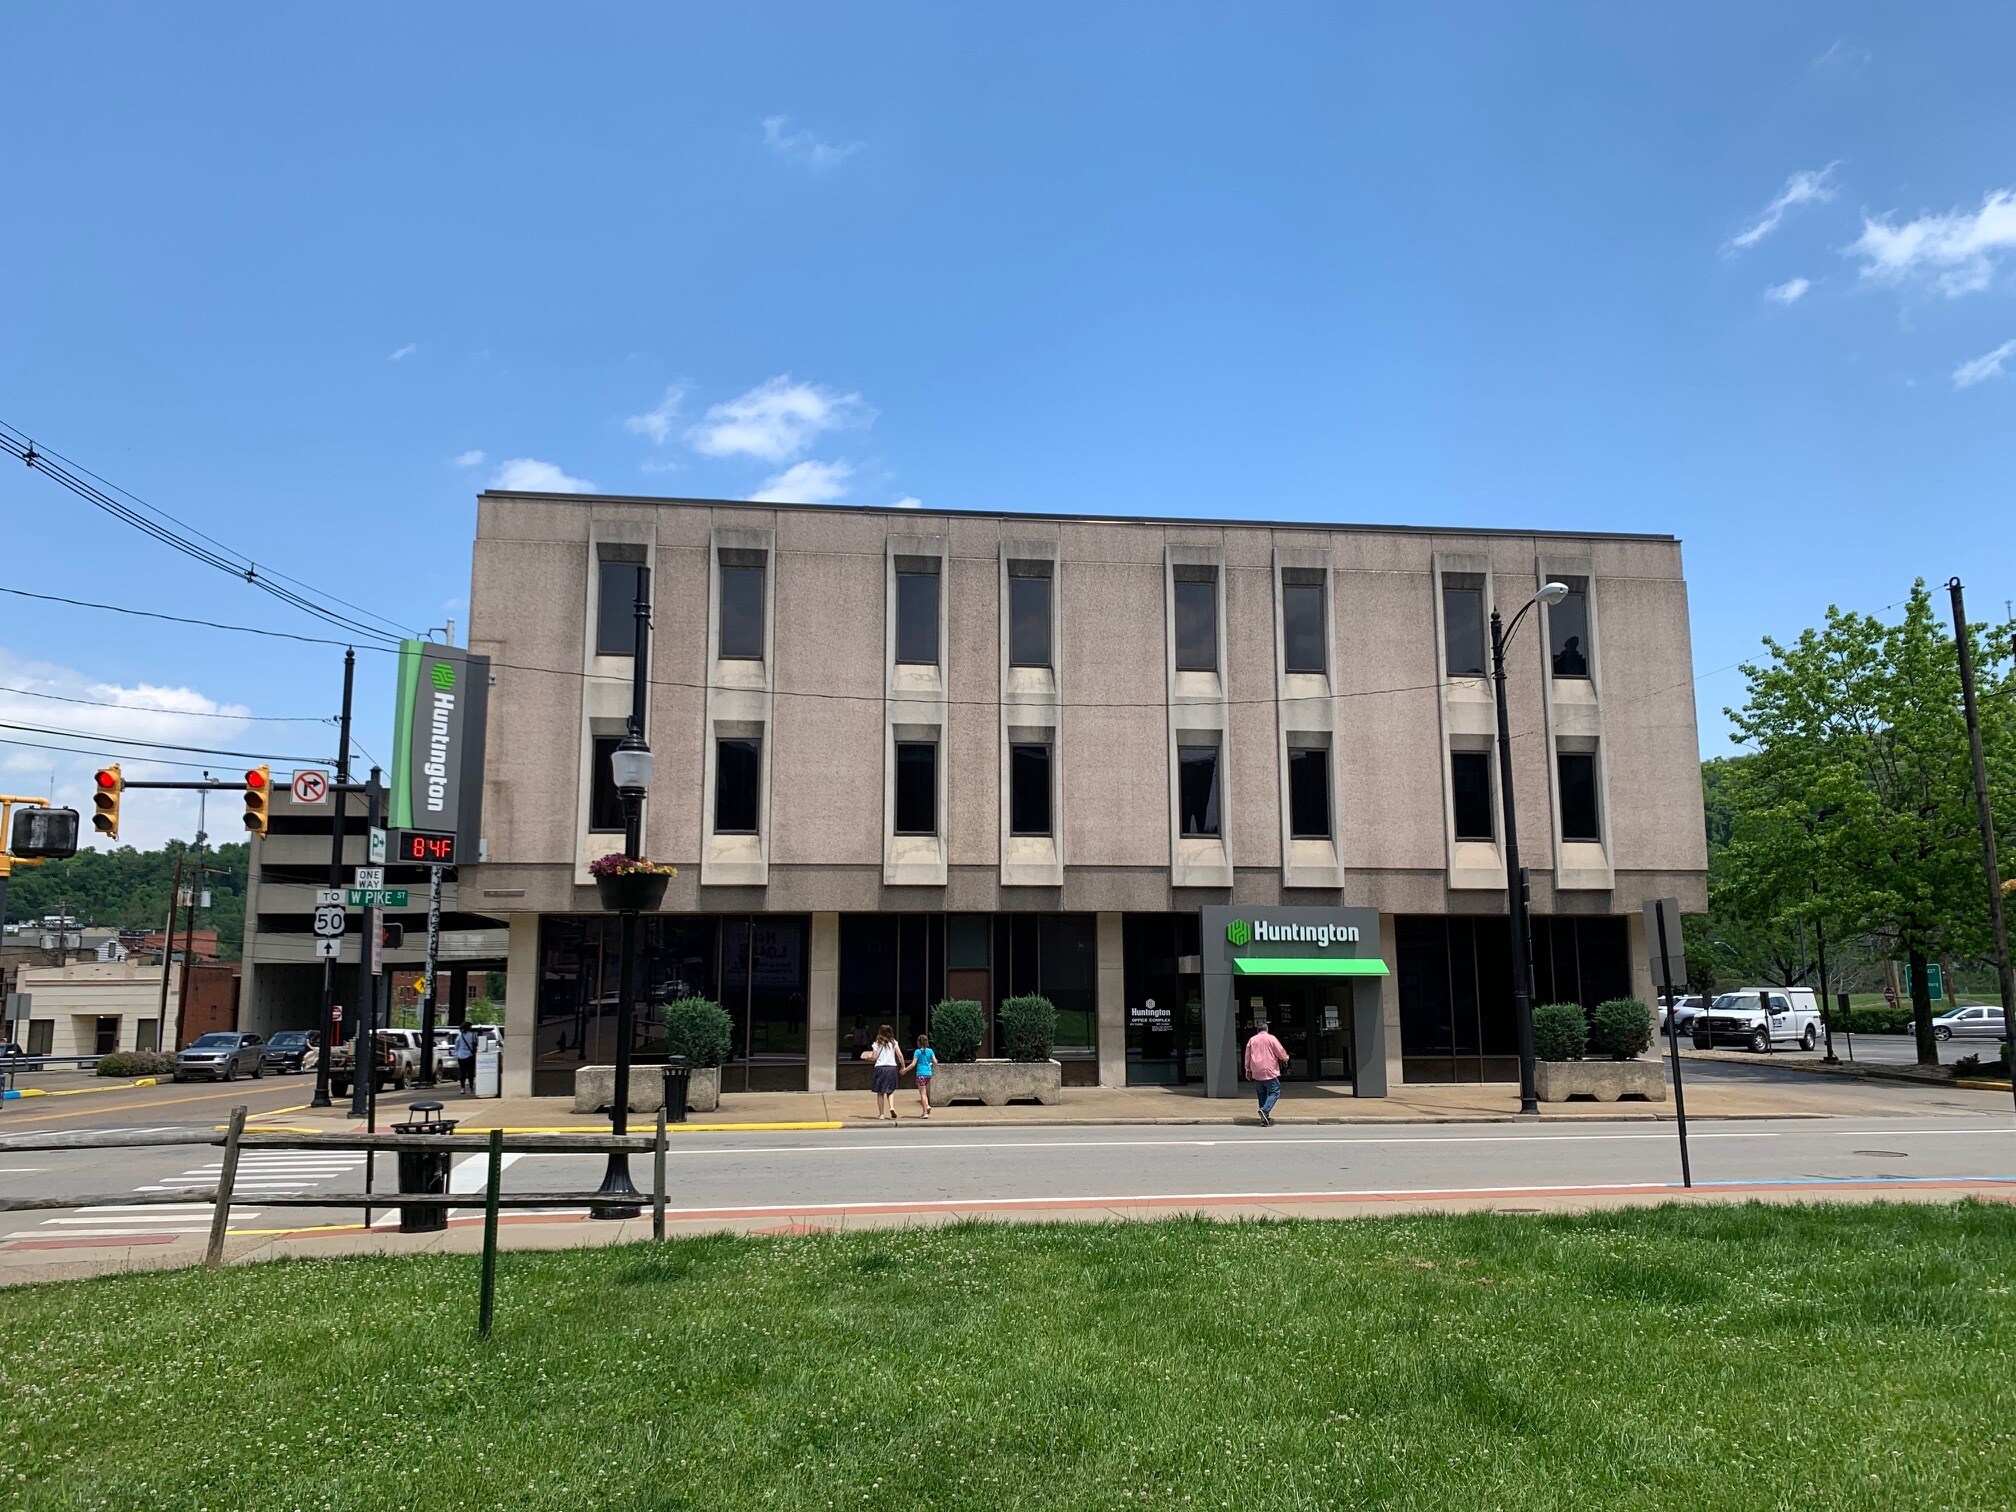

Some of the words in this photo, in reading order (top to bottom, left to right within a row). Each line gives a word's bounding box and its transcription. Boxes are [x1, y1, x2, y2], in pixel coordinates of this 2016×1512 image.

[424, 691, 455, 811] Huntington
[413, 837, 451, 858] 84F
[359, 870, 380, 880] ONE
[358, 880, 380, 889] WAY
[323, 892, 340, 901] TO
[351, 891, 362, 904] W
[365, 891, 393, 905] PIKE
[317, 913, 343, 930] 50
[1253, 920, 1360, 947] Huntington
[1131, 1007, 1171, 1018] Huntington
